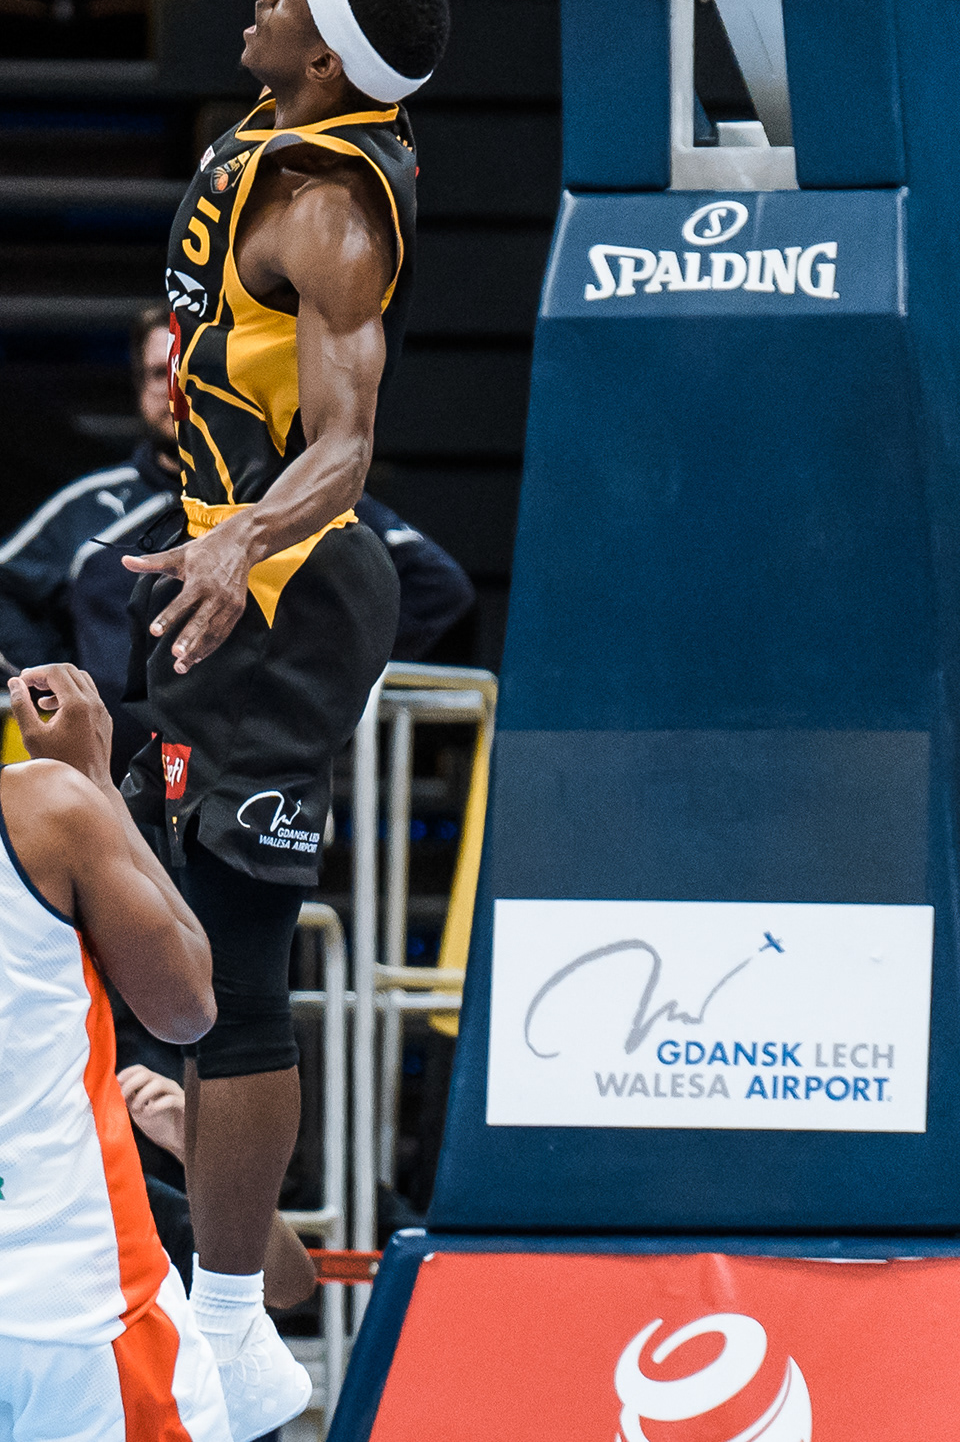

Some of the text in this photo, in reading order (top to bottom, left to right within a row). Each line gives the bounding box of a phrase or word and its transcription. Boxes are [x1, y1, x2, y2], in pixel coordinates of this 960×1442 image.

[584, 241, 840, 301] SPALDING
[656, 1039, 895, 1069] GDANSK LECH
[594, 1071, 890, 1102] WALESA AIRPORT
